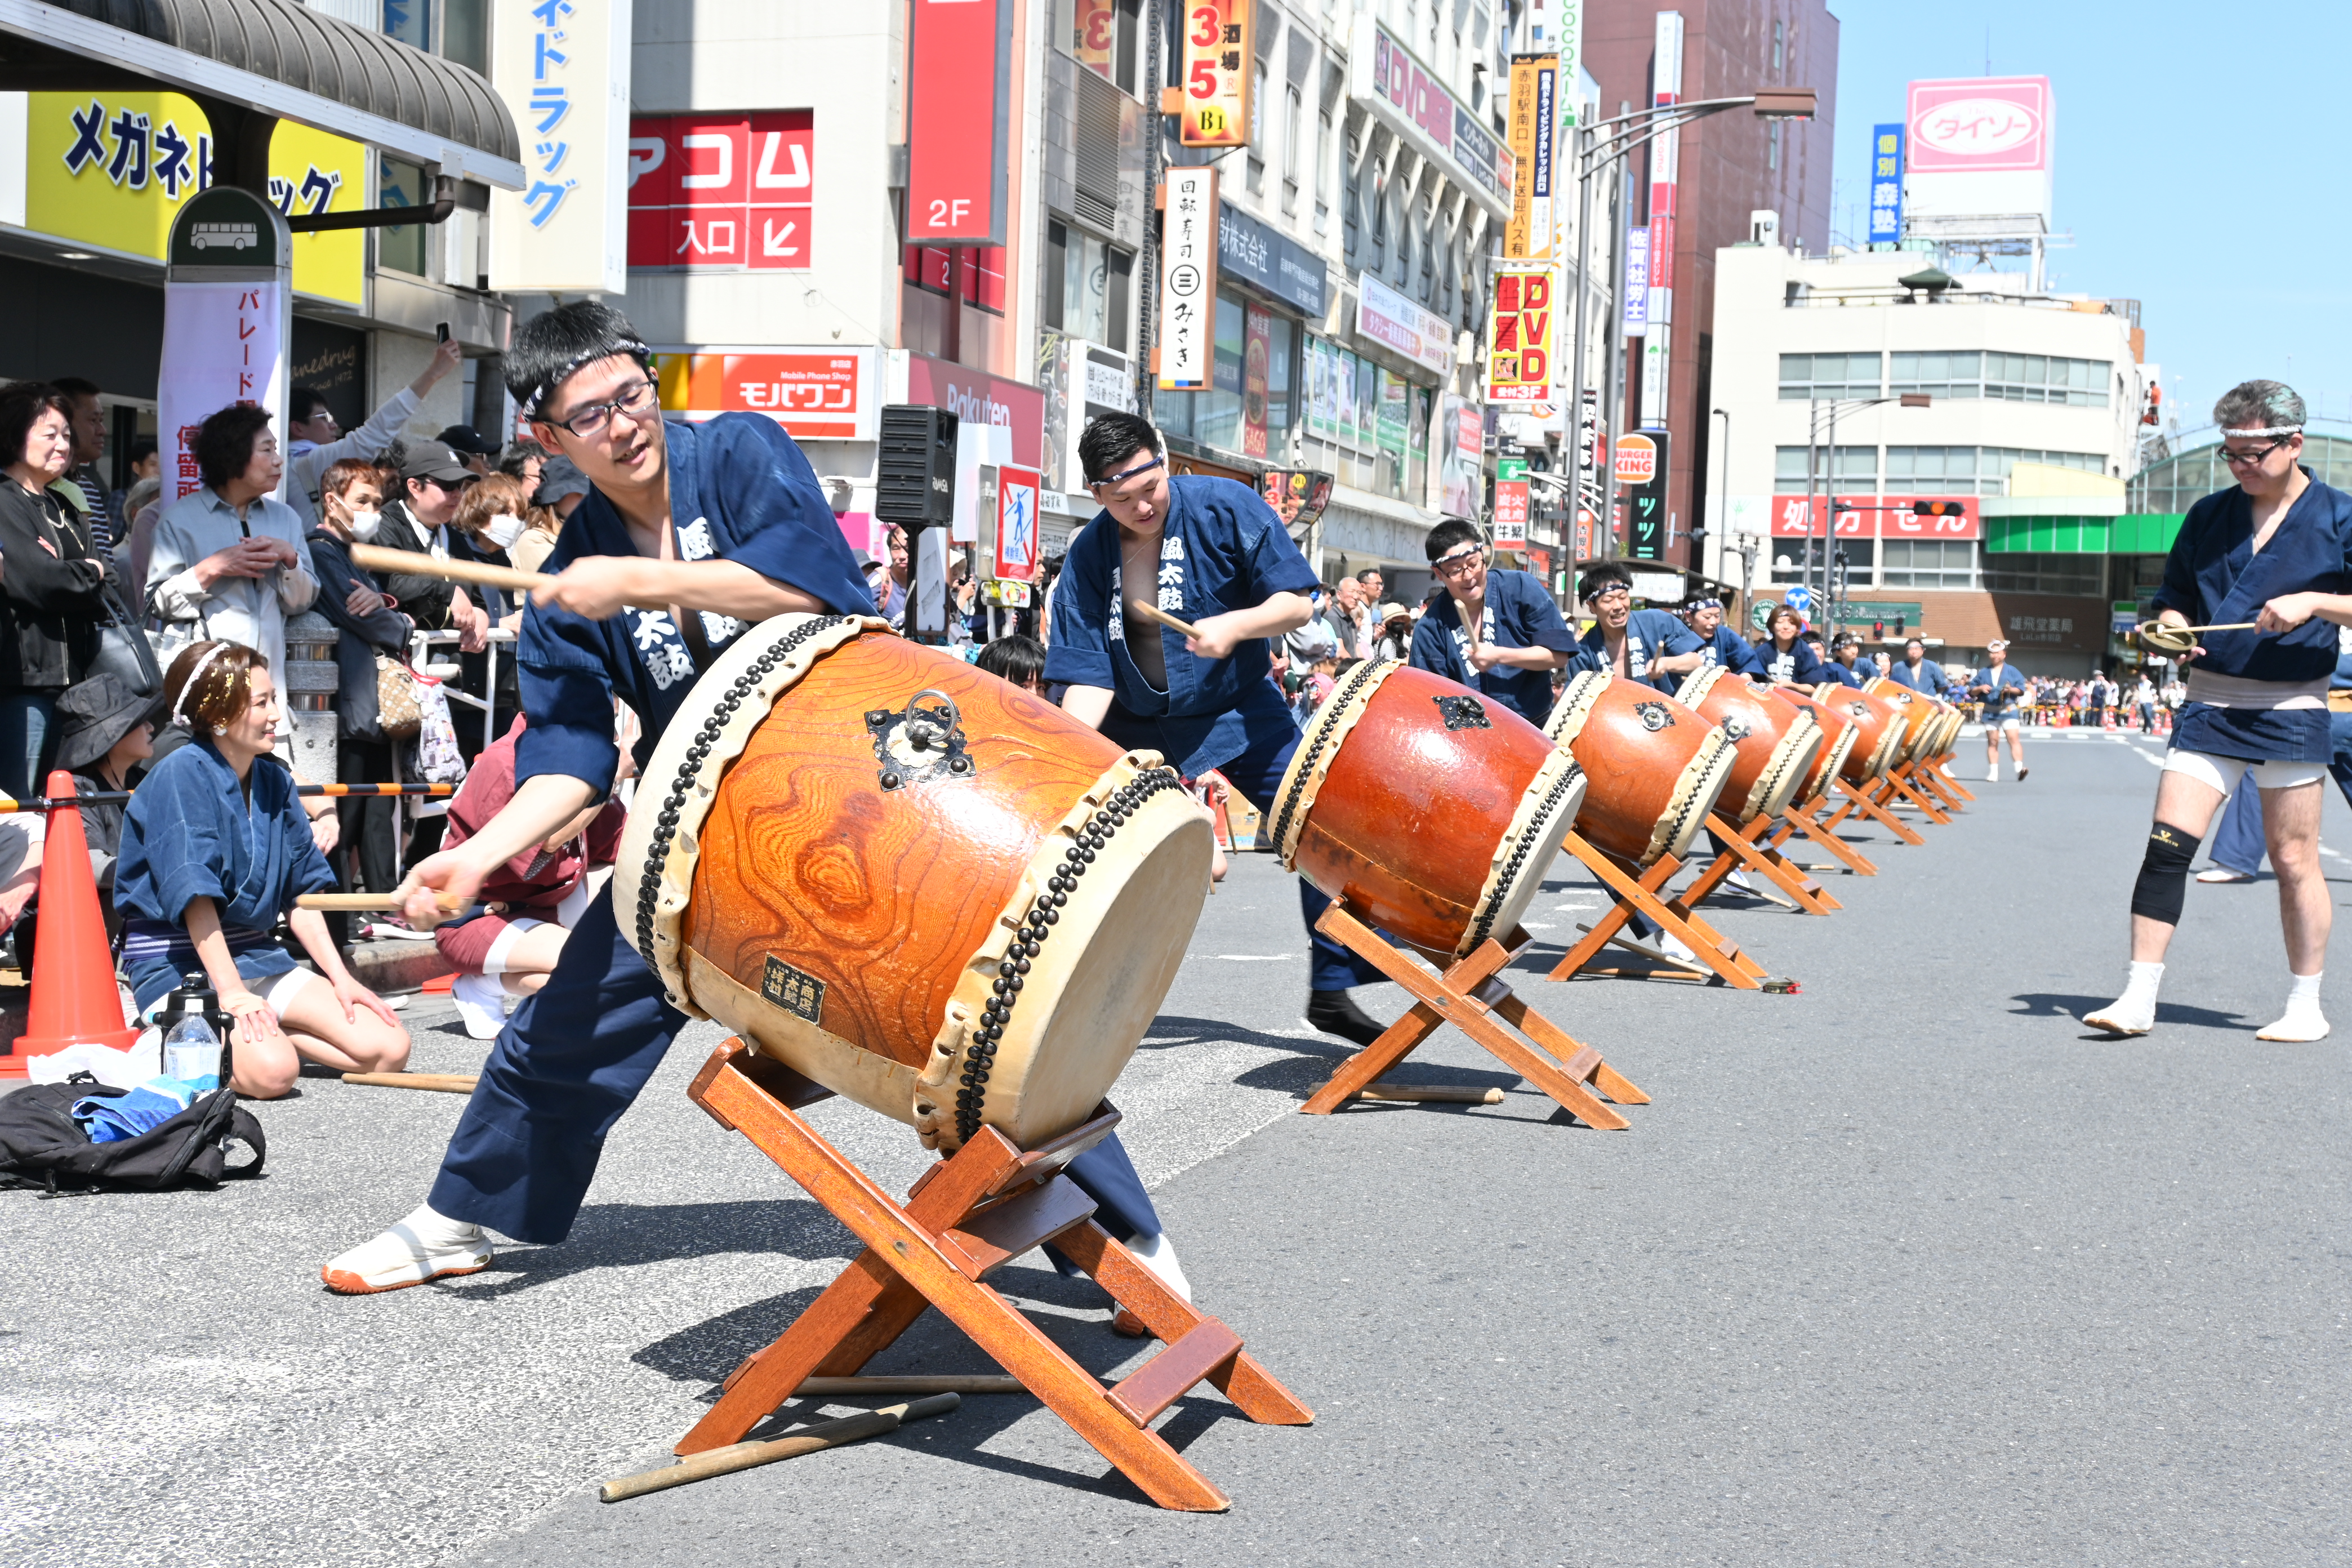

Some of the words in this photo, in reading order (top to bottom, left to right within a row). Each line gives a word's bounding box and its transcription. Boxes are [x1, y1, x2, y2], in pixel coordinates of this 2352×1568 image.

[1220, 24, 1241, 72] 酒場
[928, 199, 971, 228] 2F
[676, 220, 736, 255] 入口
[1628, 230, 1648, 320] 佐賀社労士
[1521, 275, 1549, 382] DVD
[780, 371, 806, 380] Mobile
[807, 371, 830, 380] Phone
[831, 372, 852, 382] Shop
[830, 359, 852, 368] 赤羽店
[739, 382, 852, 408] モバワン
[947, 383, 1010, 426] Rakuten
[1157, 536, 1185, 611] 風太鼓
[2010, 615, 2073, 632] 雄飛堂薬局
